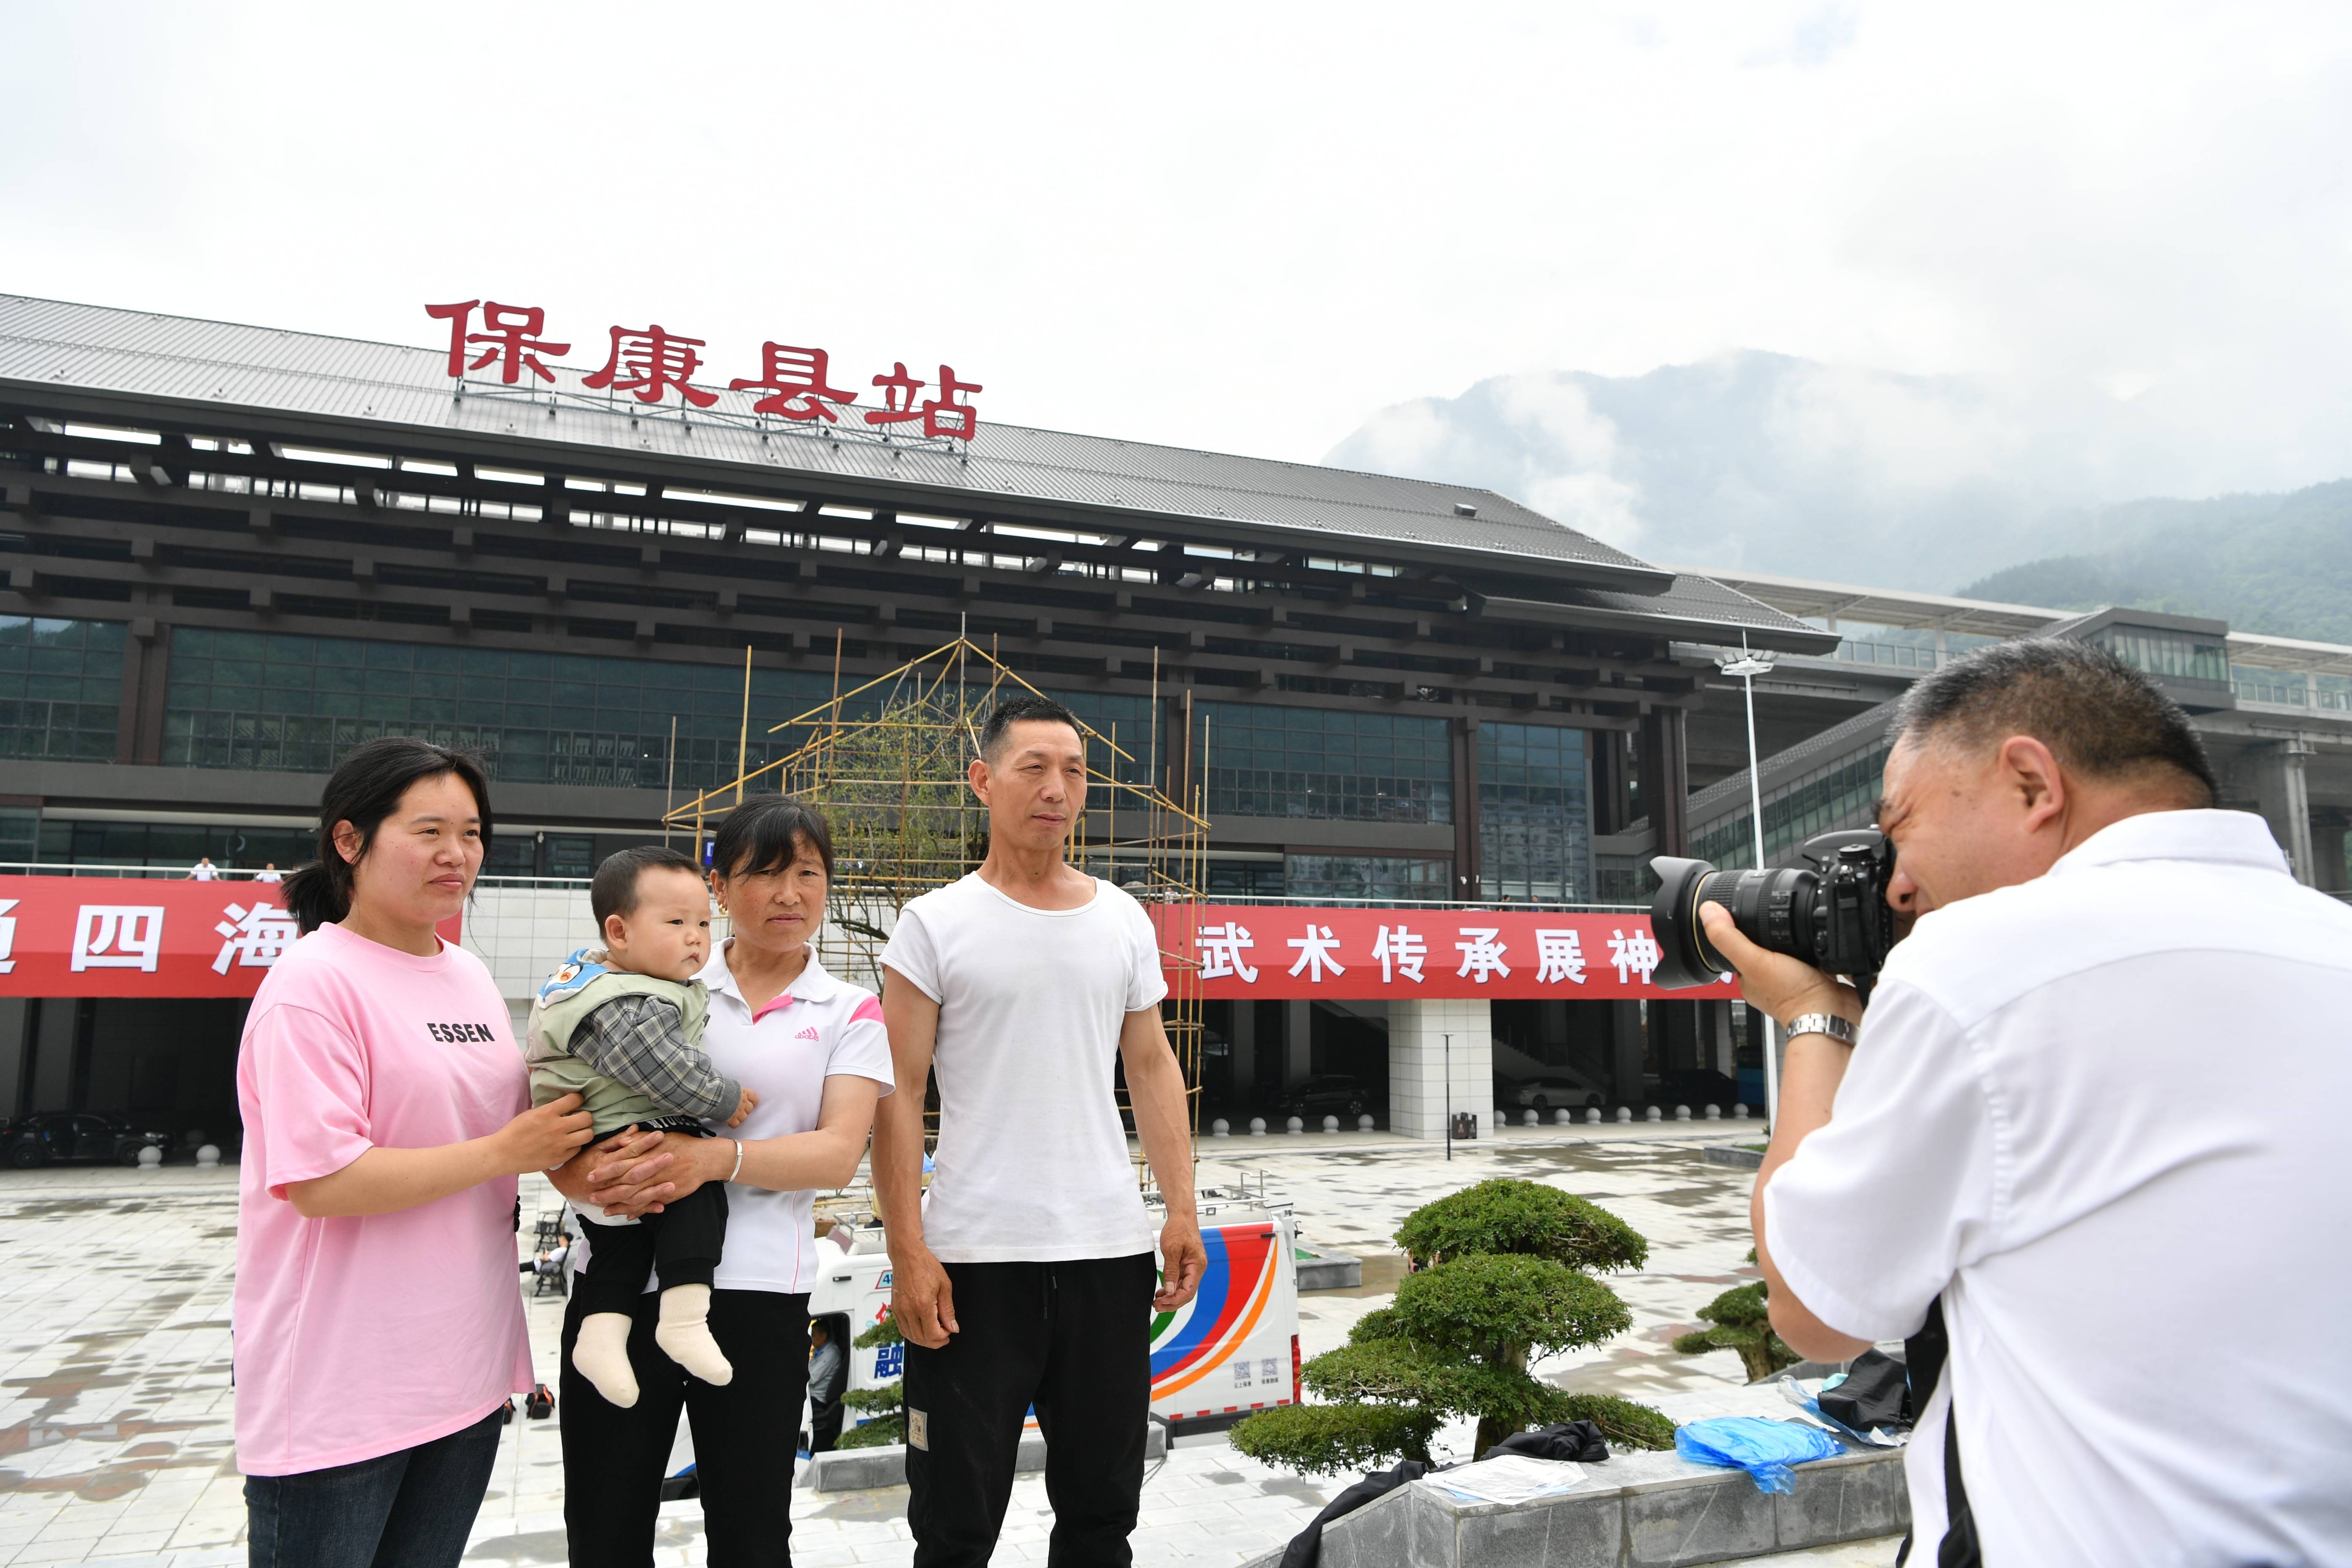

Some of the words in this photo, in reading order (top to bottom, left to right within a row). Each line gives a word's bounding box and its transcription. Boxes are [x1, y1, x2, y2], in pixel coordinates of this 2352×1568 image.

[424, 299, 983, 441] 保康县站
[0, 899, 299, 976] 四海
[1195, 922, 1733, 985] 武术传承展神
[427, 1023, 495, 1043] ESSEN
